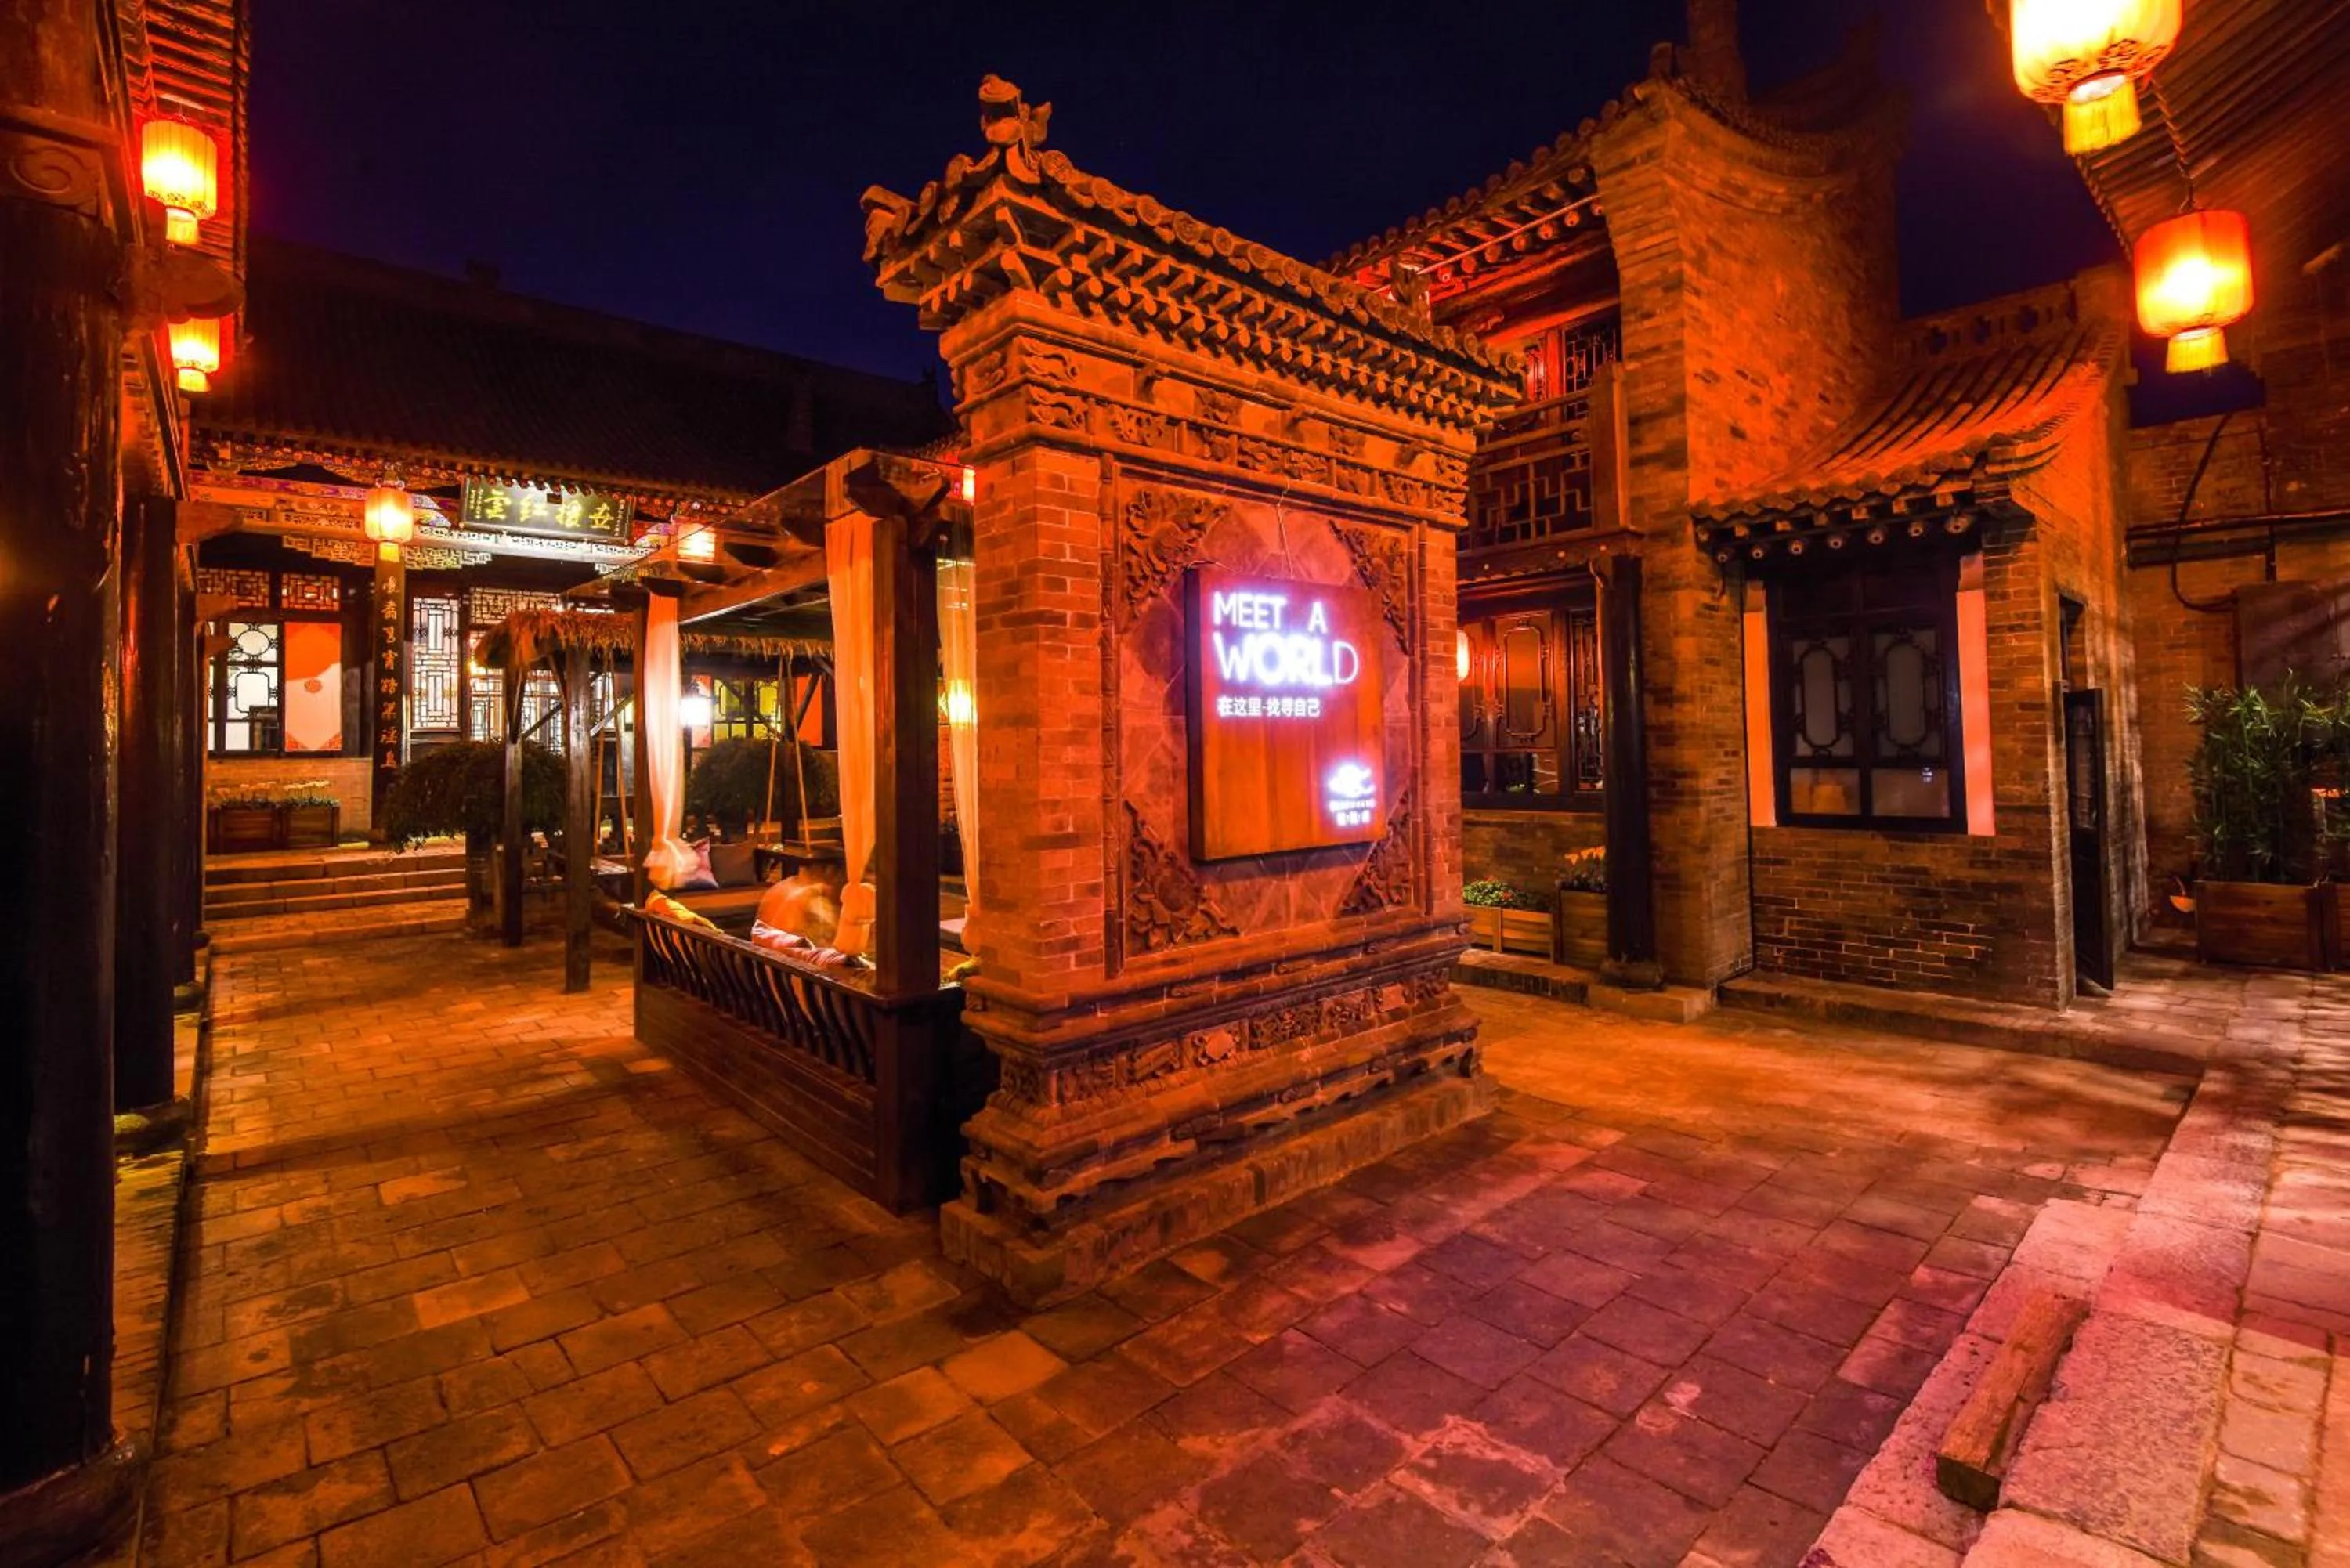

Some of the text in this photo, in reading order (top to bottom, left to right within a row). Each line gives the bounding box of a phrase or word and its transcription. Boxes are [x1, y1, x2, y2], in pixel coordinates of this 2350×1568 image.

[1213, 591, 1329, 634] MEET A
[1213, 632, 1360, 685] WORLD
